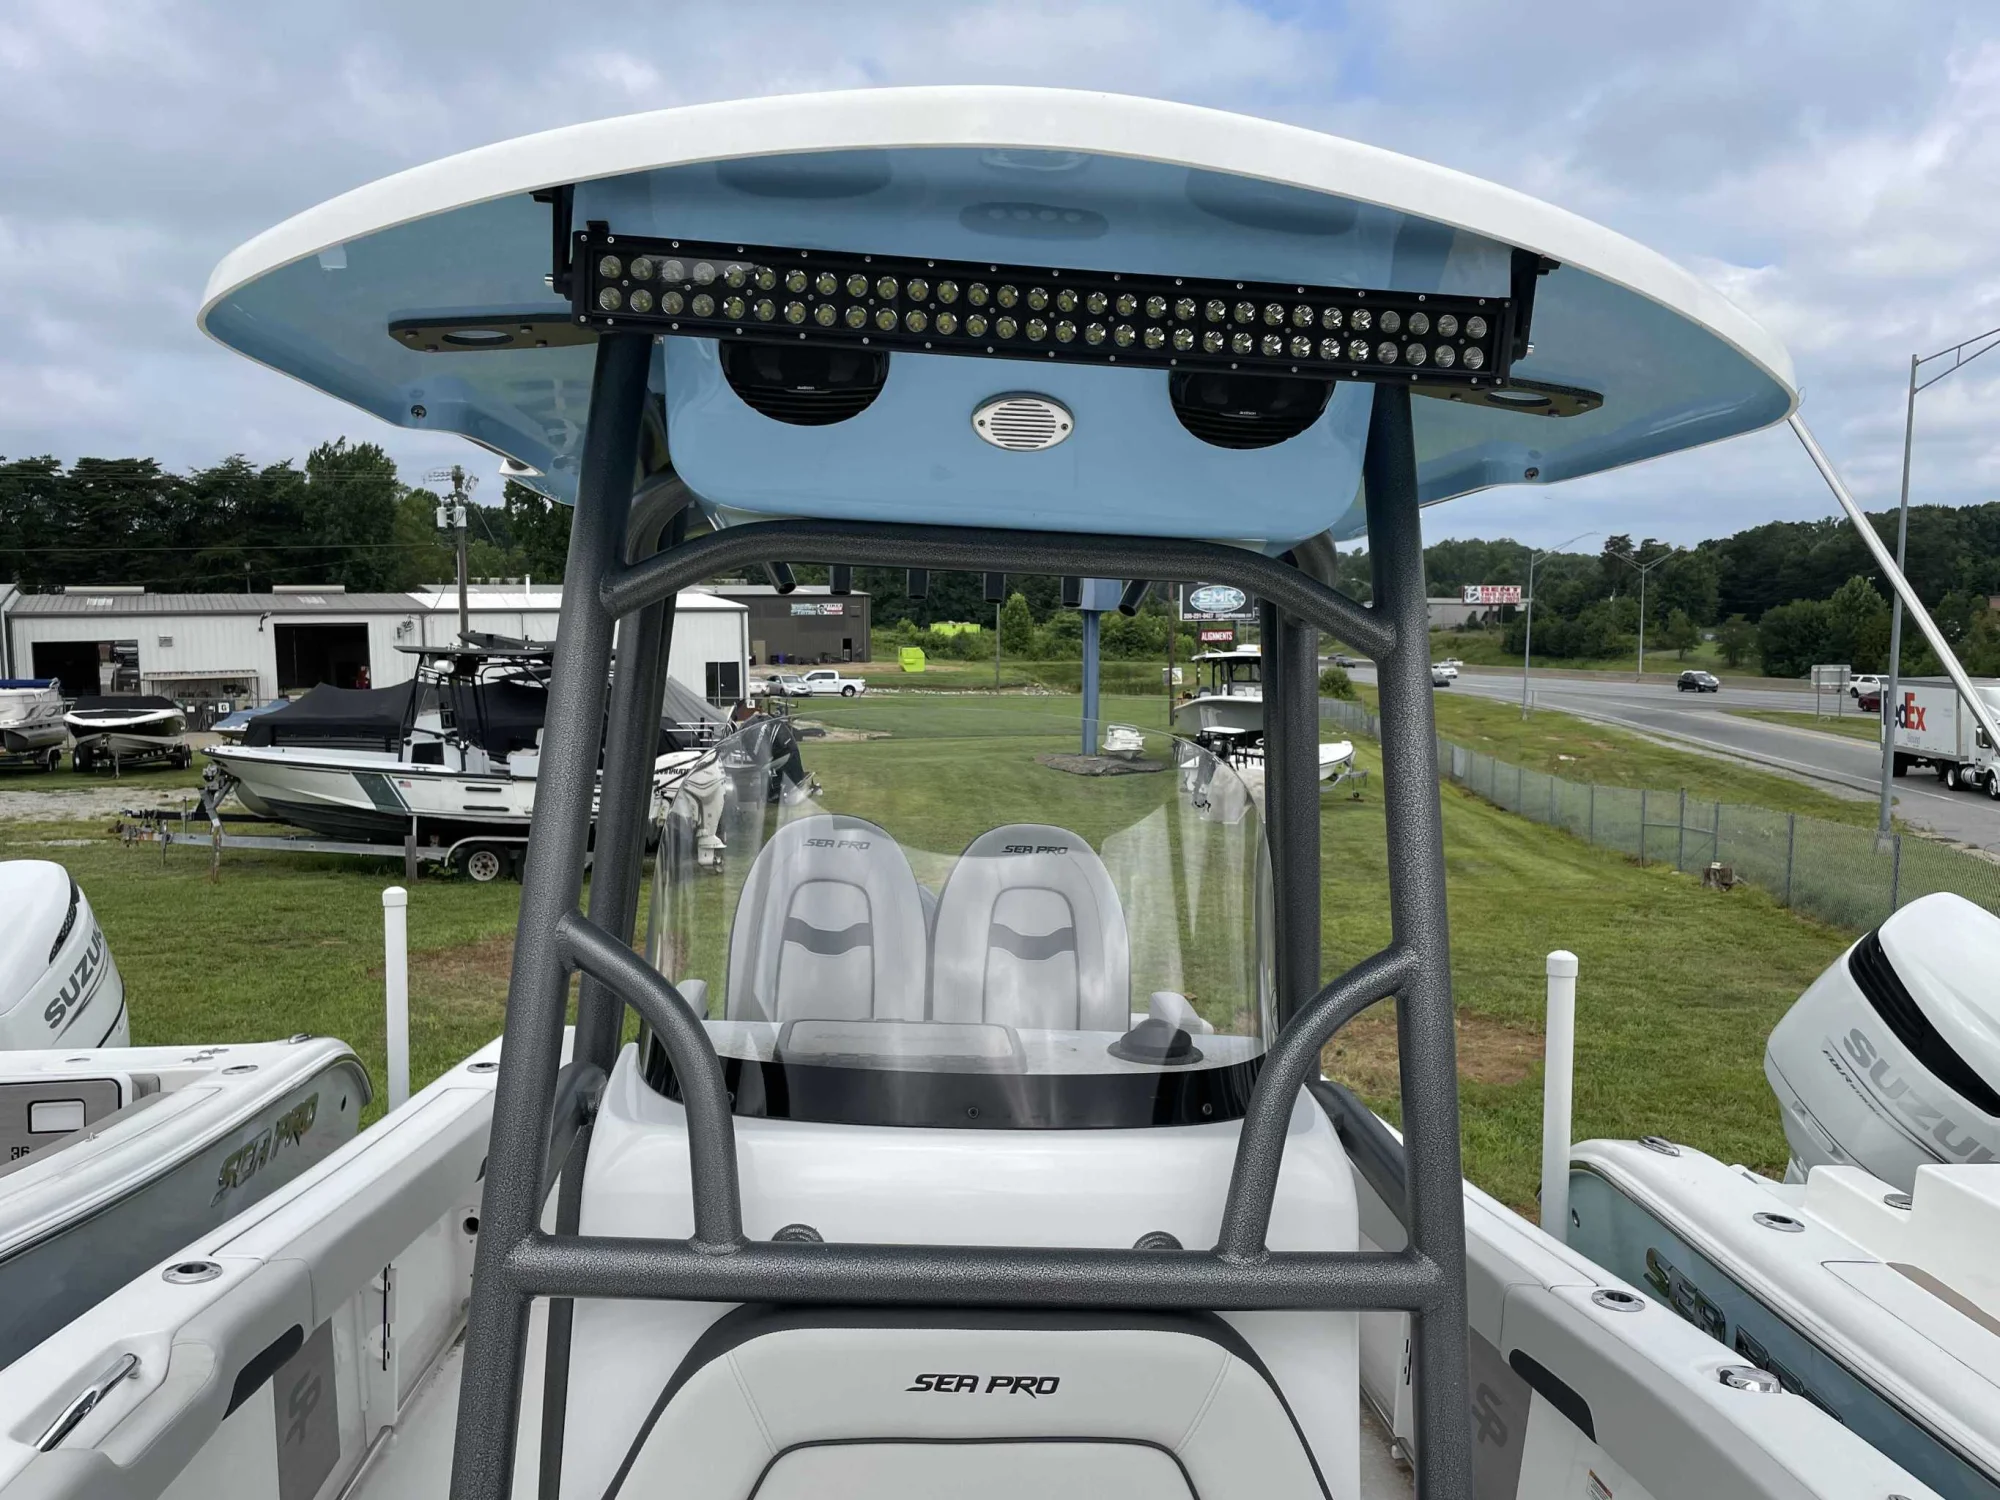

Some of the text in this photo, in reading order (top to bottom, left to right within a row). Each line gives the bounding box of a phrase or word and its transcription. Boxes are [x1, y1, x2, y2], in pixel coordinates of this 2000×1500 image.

[1199, 590, 1238, 606] SMR
[1201, 631, 1233, 641] ALIGNMENTS
[803, 838, 870, 850] SEA PRO
[1001, 845, 1069, 856] SEA PRO
[1844, 1028, 2000, 1164] SUZU
[904, 1374, 1060, 1399] SEA PRO
